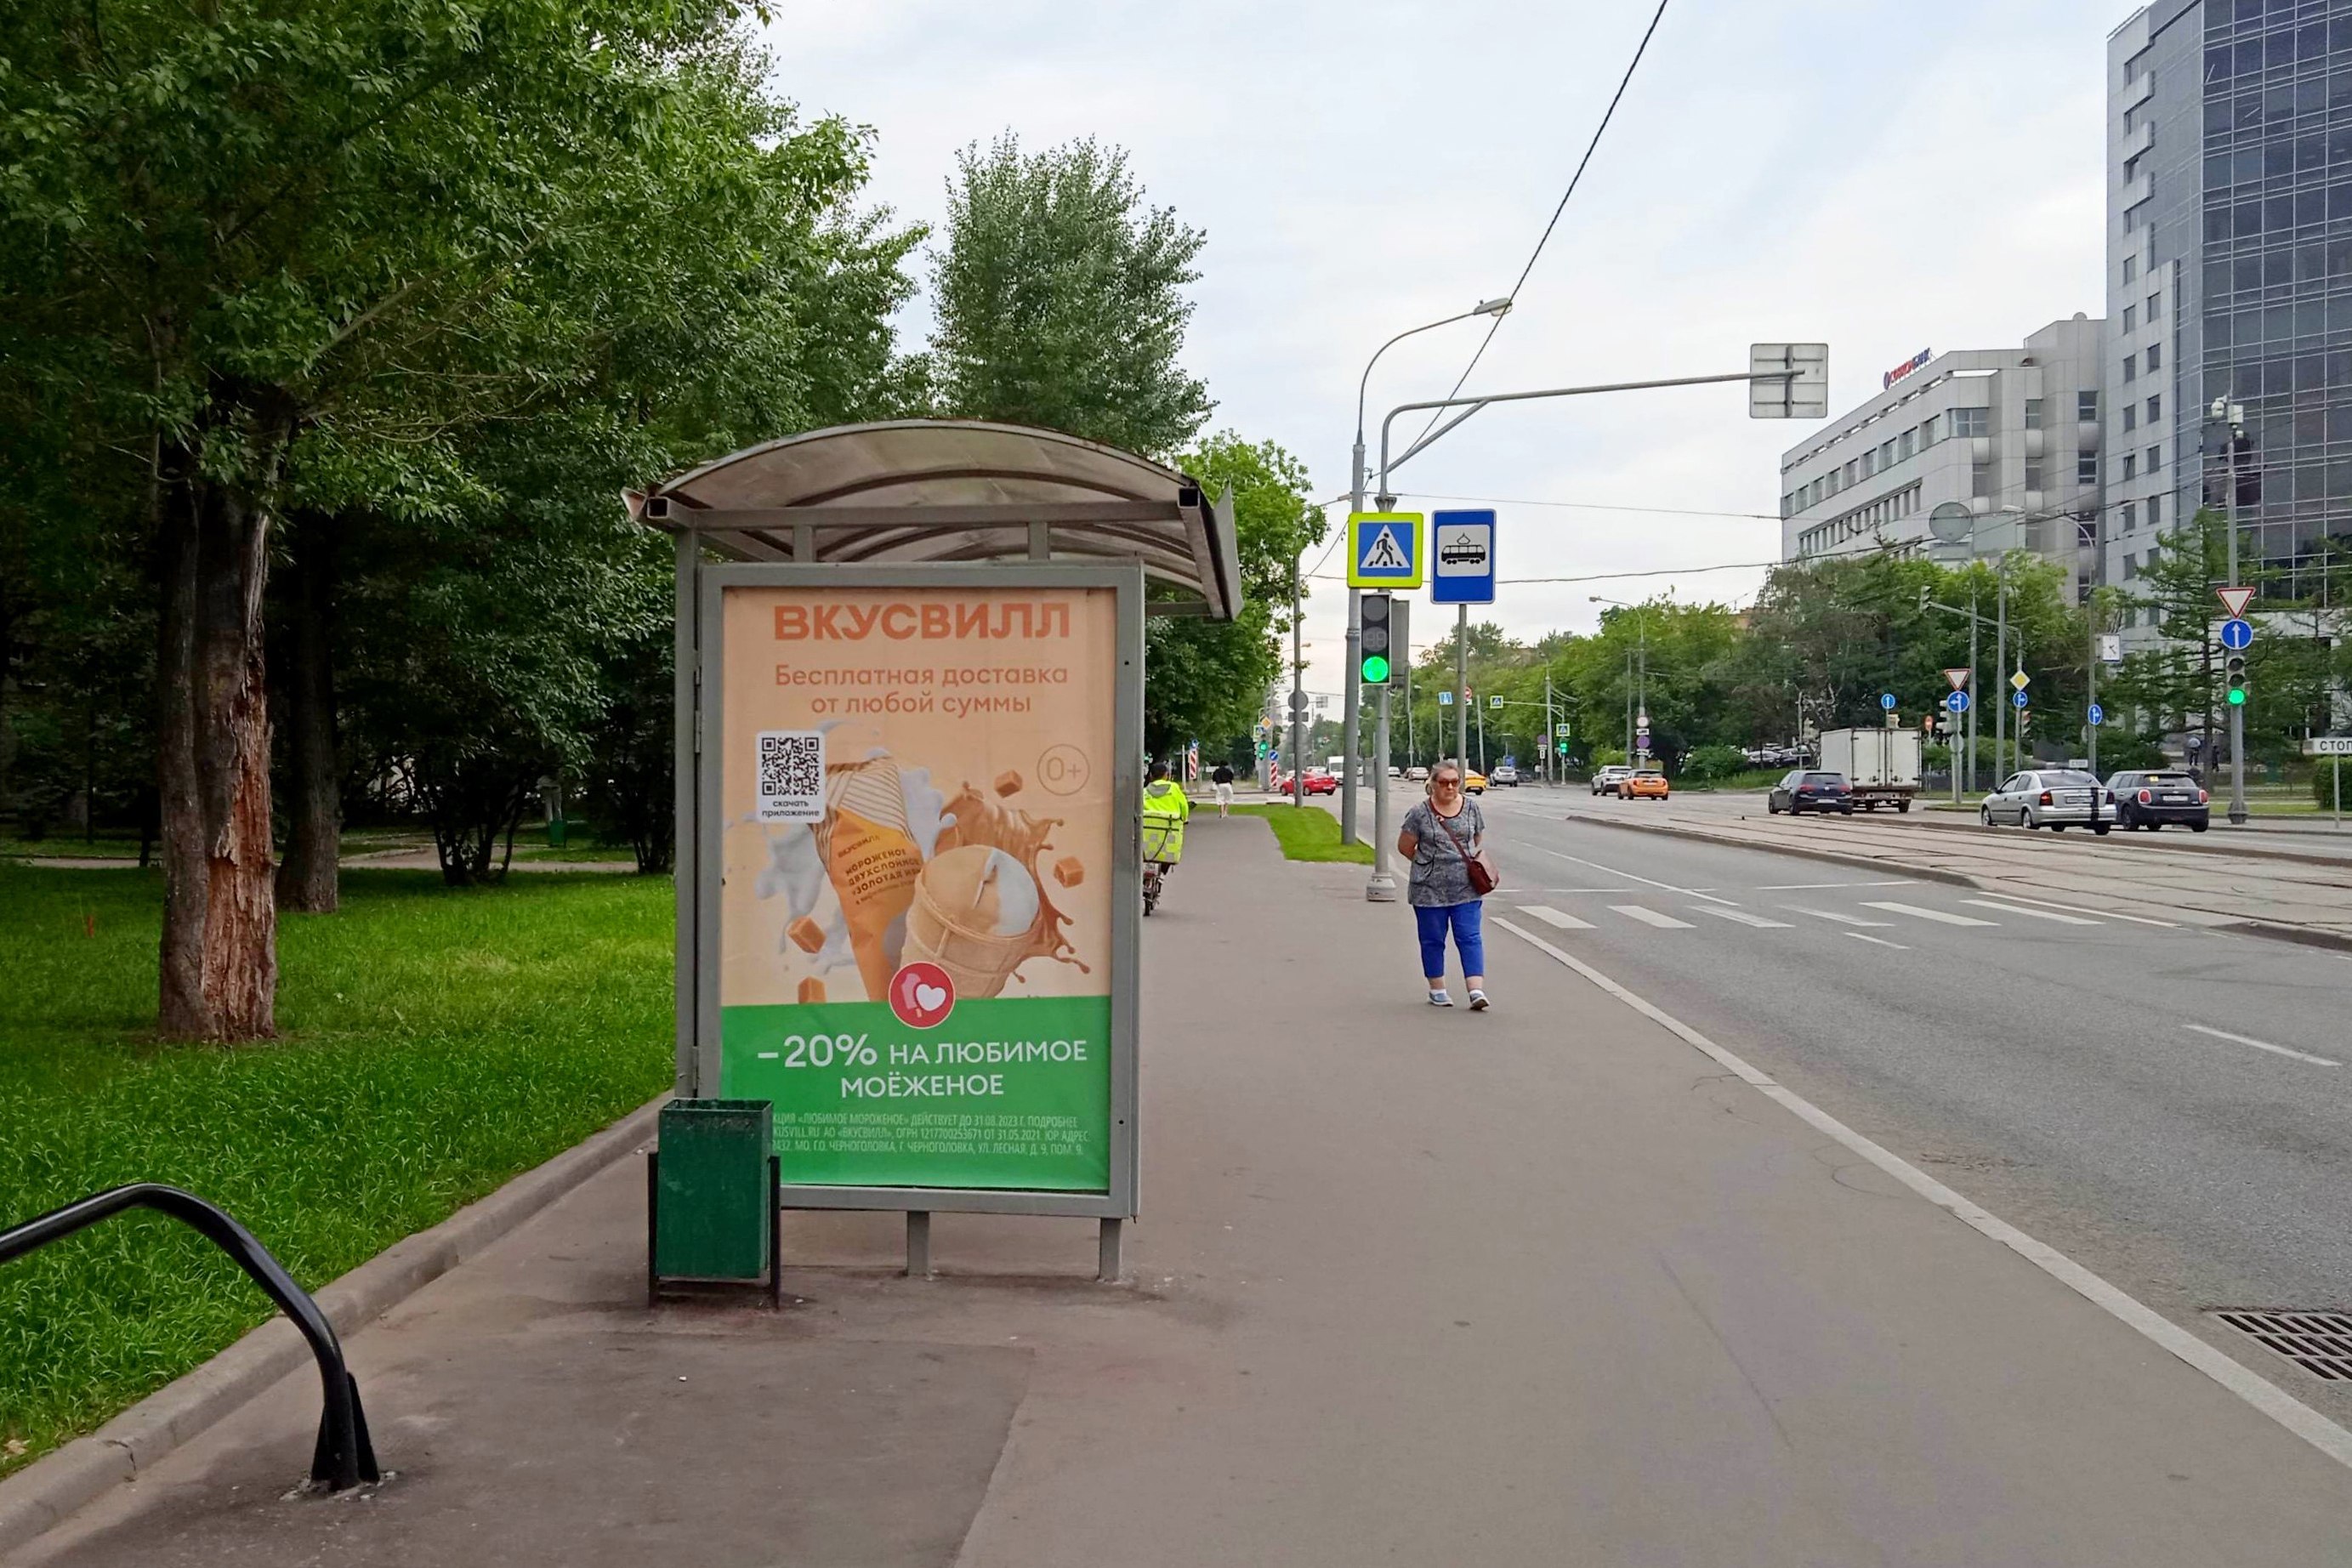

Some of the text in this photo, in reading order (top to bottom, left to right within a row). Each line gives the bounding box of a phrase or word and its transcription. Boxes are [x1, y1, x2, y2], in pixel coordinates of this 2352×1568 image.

[774, 603, 1070, 640] ВКУСВИЛЛ
[775, 664, 1068, 688] Бесплатная доставка
[811, 689, 1031, 719] от любой суммы
[2320, 741, 2352, 751] СТОП
[1047, 757, 1082, 781] 0+
[757, 1034, 1088, 1068] -20% НА ЛЮБИМОЕ
[841, 1072, 1004, 1098] МОЁЖЕНОЕ
[773, 1114, 796, 1125] КЦИЯ
[911, 1112, 957, 1127] ДЕЙСТВУЕТ
[959, 1114, 971, 1128] ДО
[1027, 1116, 1077, 1128] ПОДРОБНЕЕ
[896, 1128, 918, 1139] ОГРН
[984, 1129, 995, 1139] ОТ
